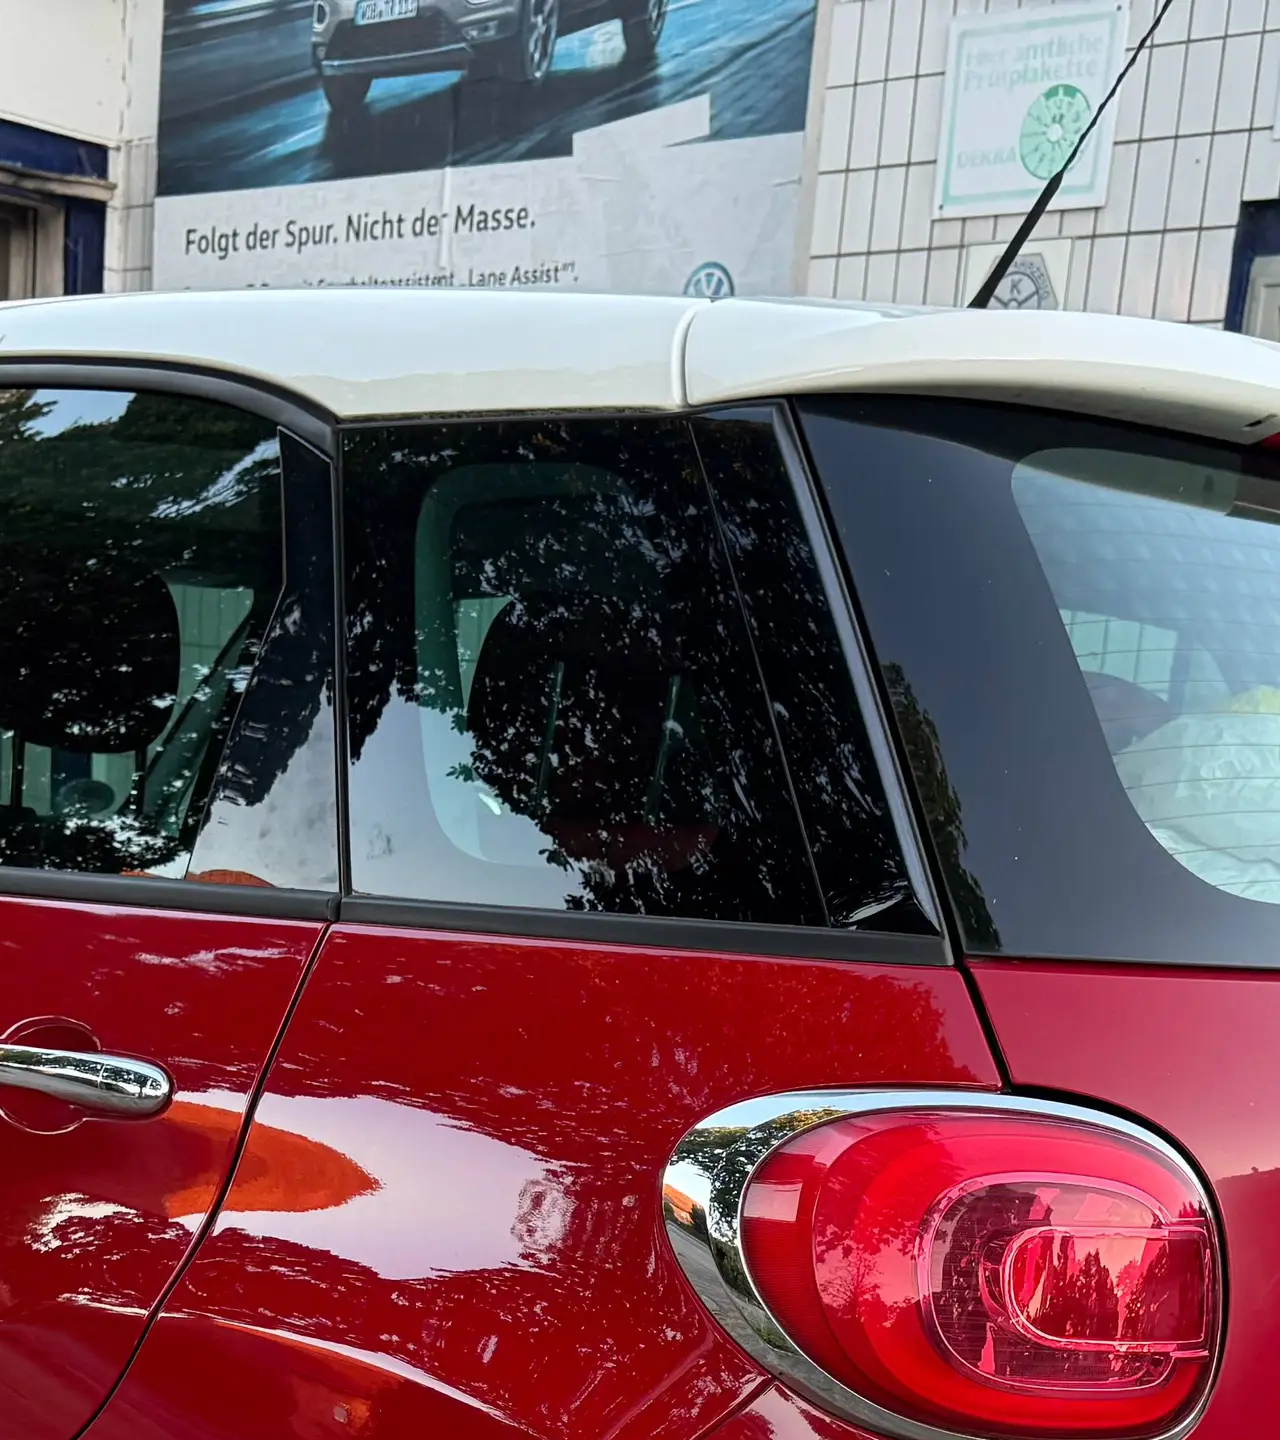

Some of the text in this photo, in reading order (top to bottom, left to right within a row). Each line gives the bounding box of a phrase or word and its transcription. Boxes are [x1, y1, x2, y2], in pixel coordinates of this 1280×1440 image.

[184, 225, 240, 261] Folgt
[245, 222, 280, 251] der
[284, 219, 339, 254] Spur.
[345, 209, 405, 243] Nicht
[453, 203, 536, 234] Masse.
